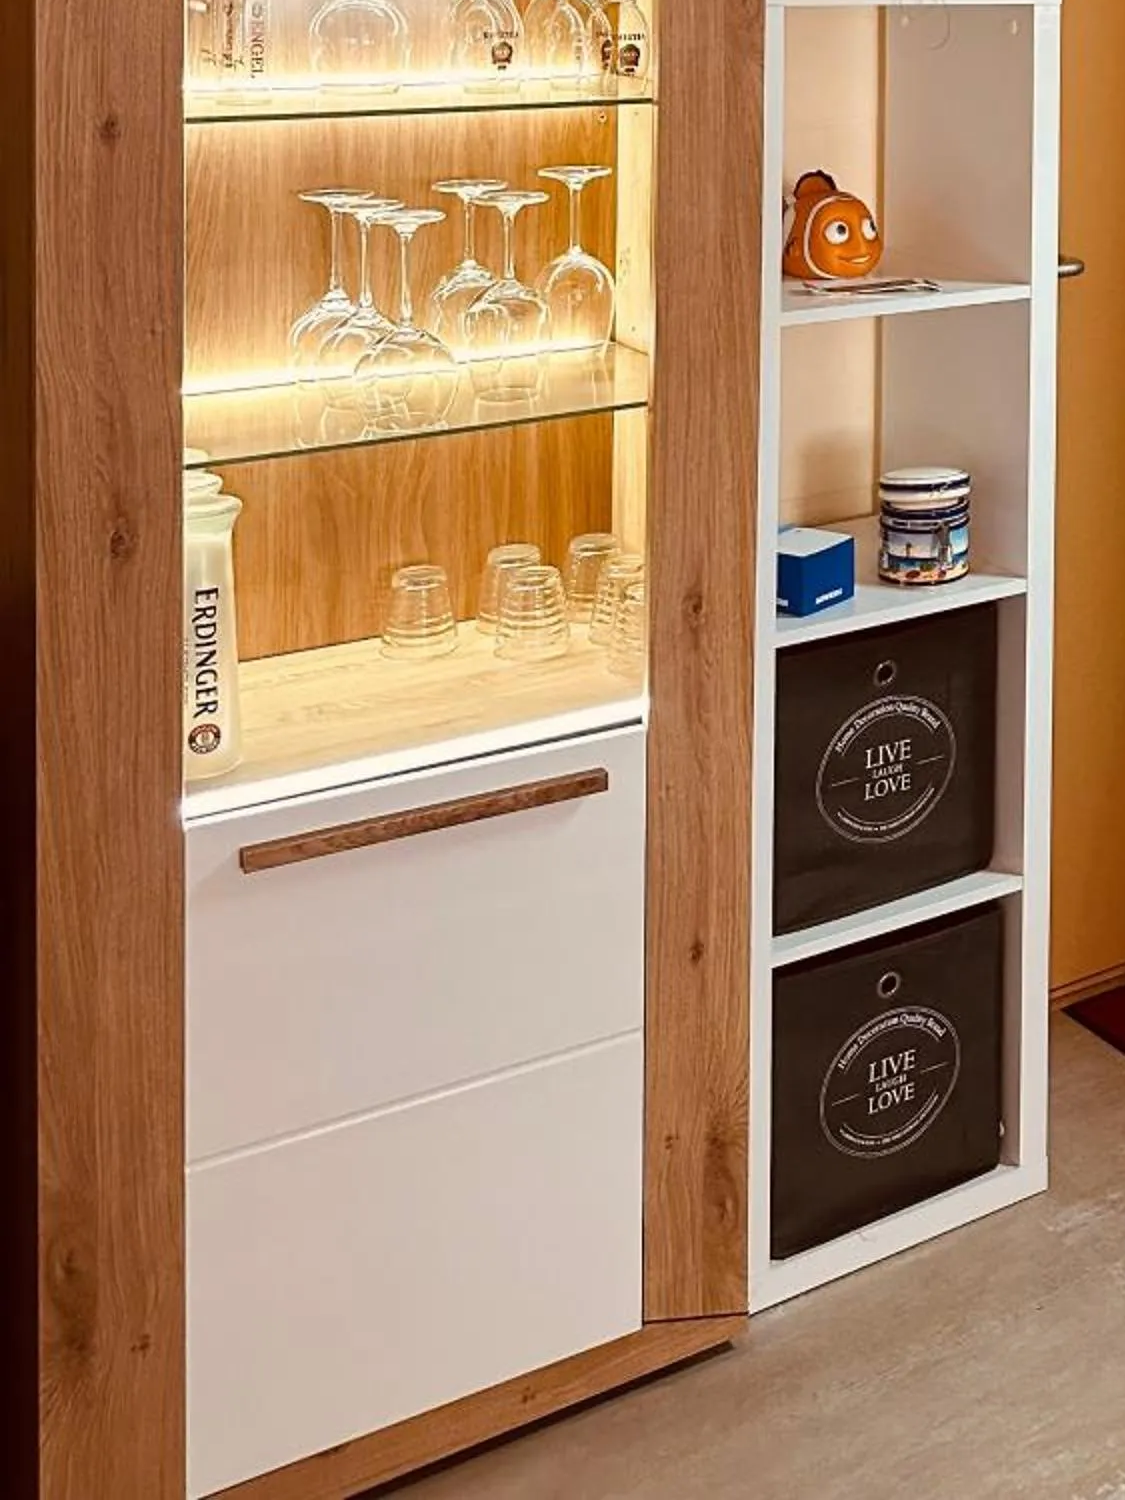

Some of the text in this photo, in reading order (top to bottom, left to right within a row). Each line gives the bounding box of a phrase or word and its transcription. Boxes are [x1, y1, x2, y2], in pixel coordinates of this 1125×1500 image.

[191, 587, 219, 718] ERDINGER
[865, 739, 912, 769] LIVE
[873, 763, 904, 779] LAUGH
[864, 773, 911, 801] LOVE
[869, 1049, 916, 1083] LIVE
[868, 1082, 915, 1115] LOVE
